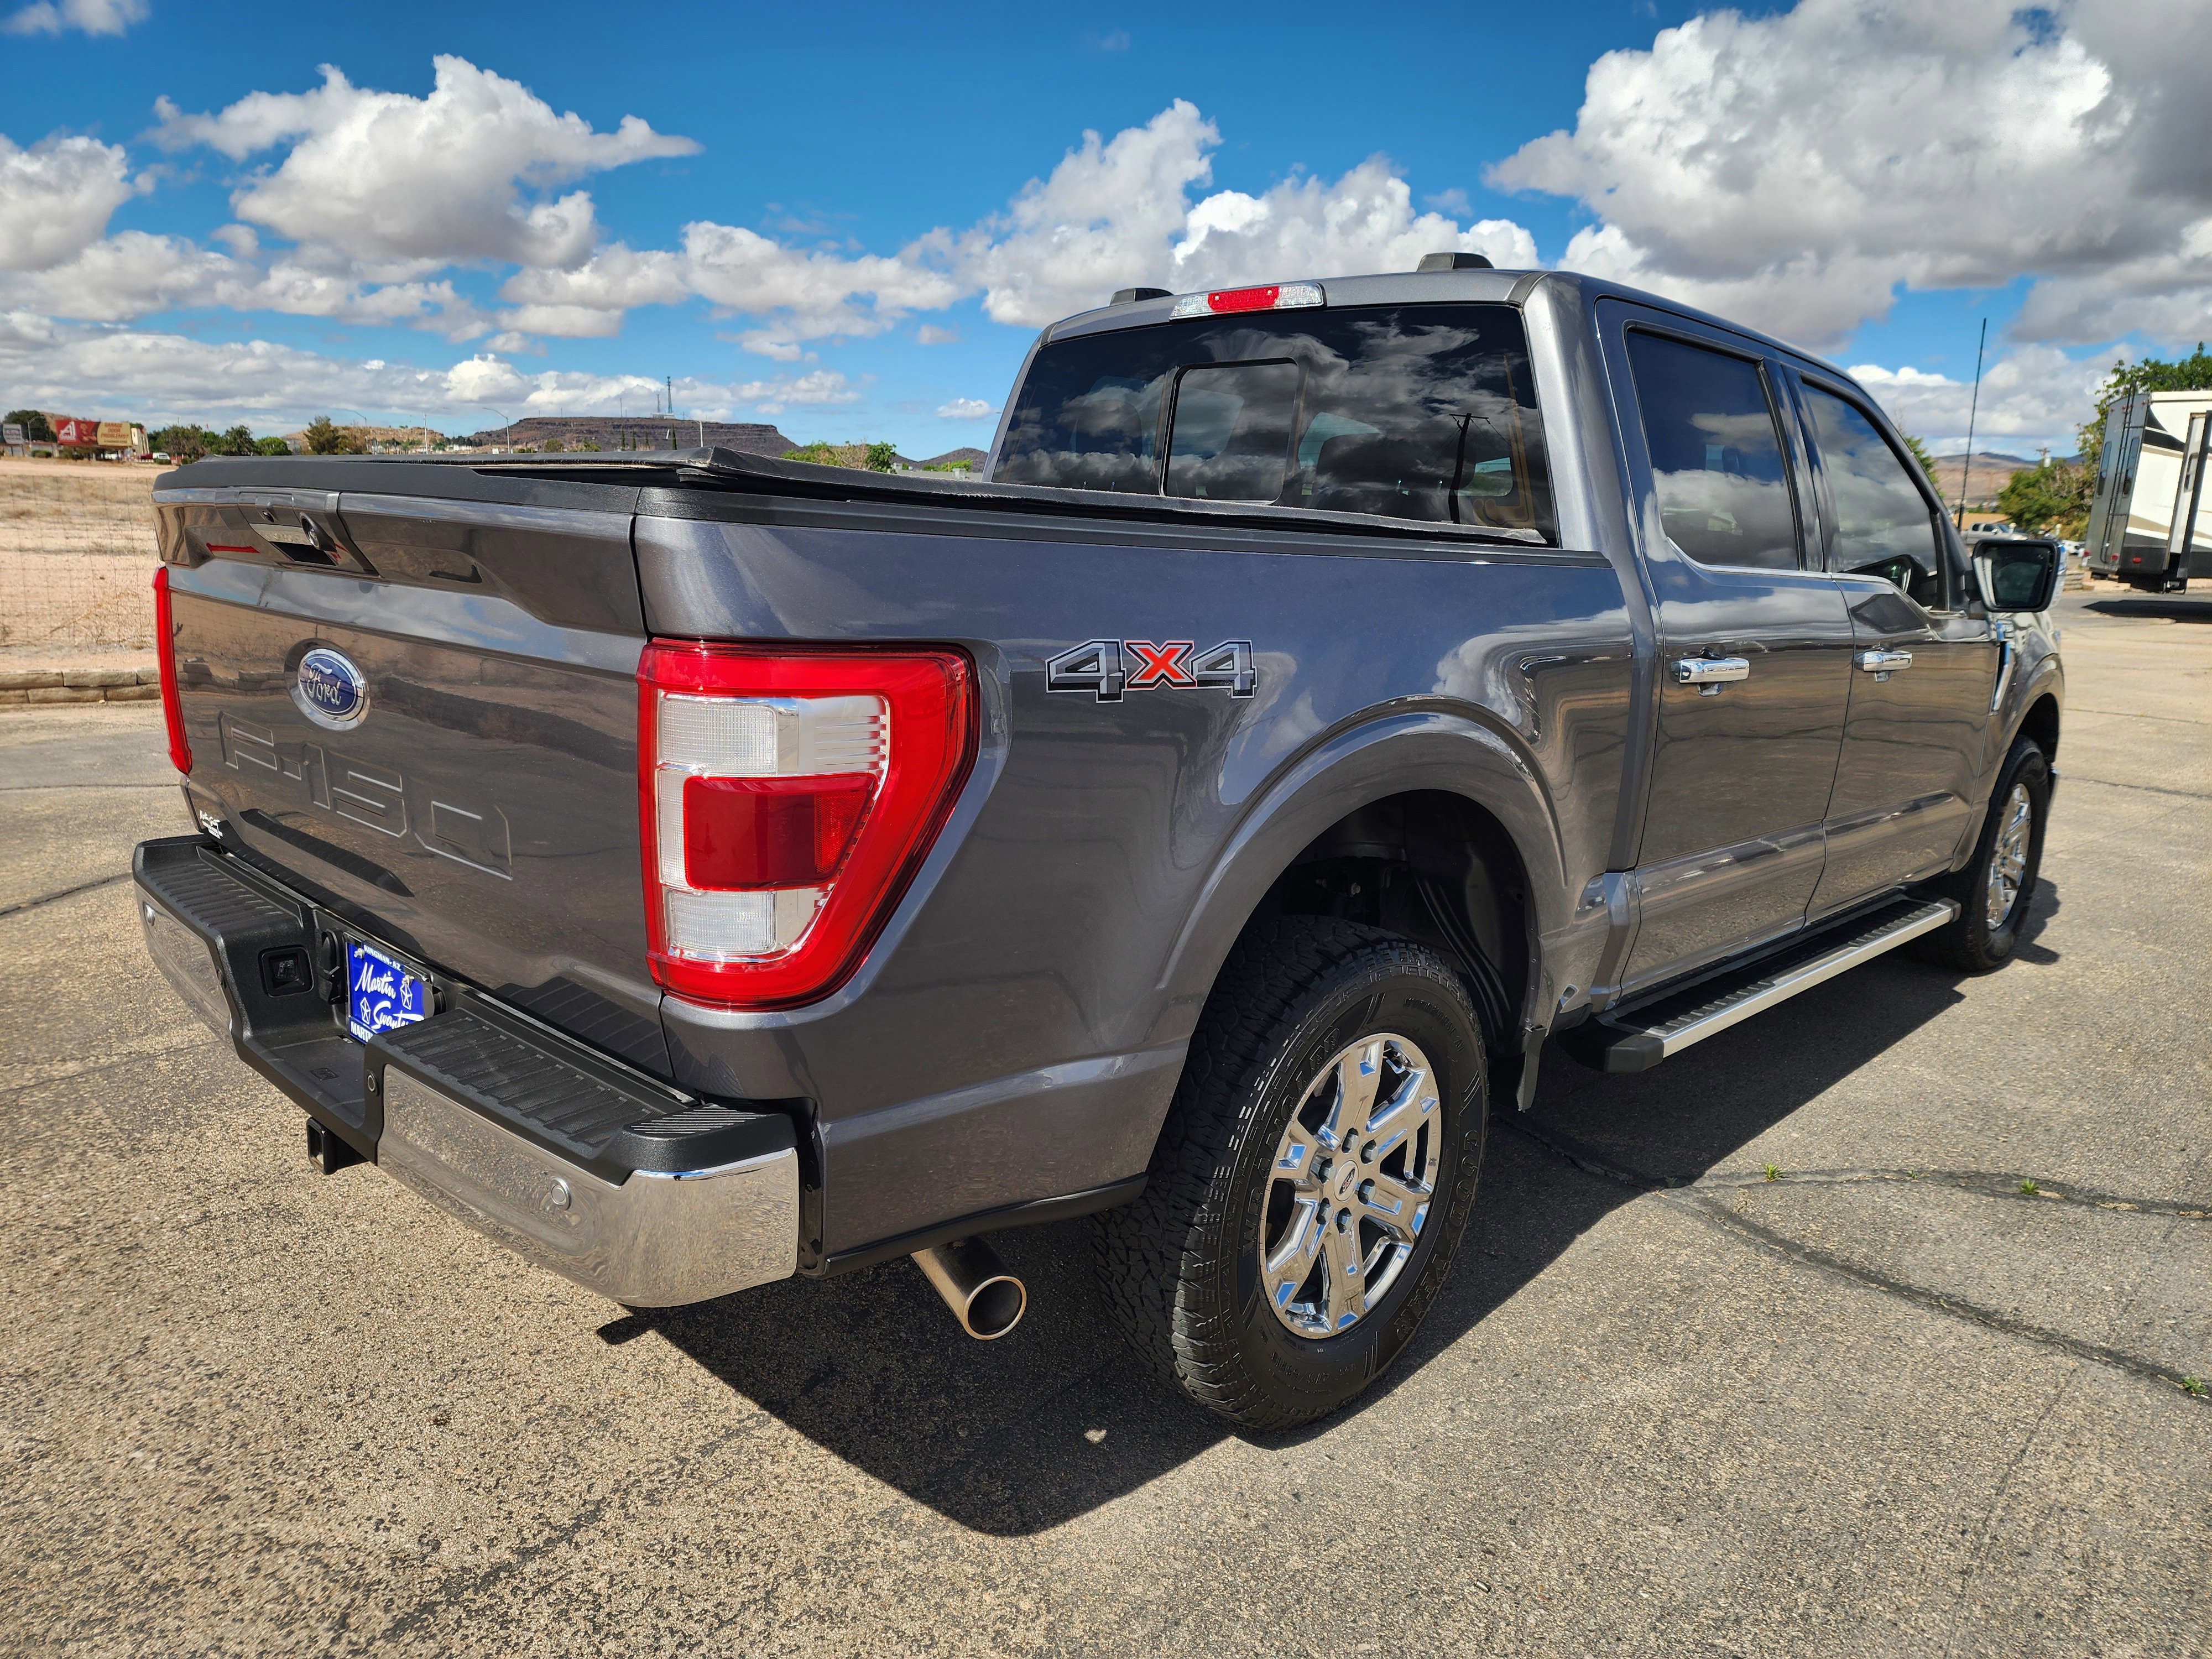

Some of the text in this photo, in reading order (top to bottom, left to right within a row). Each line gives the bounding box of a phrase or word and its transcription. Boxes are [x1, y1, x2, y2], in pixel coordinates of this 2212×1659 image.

[306, 662, 342, 707] Ford
[354, 962, 397, 1000] Martin
[392, 961, 401, 971] AZ
